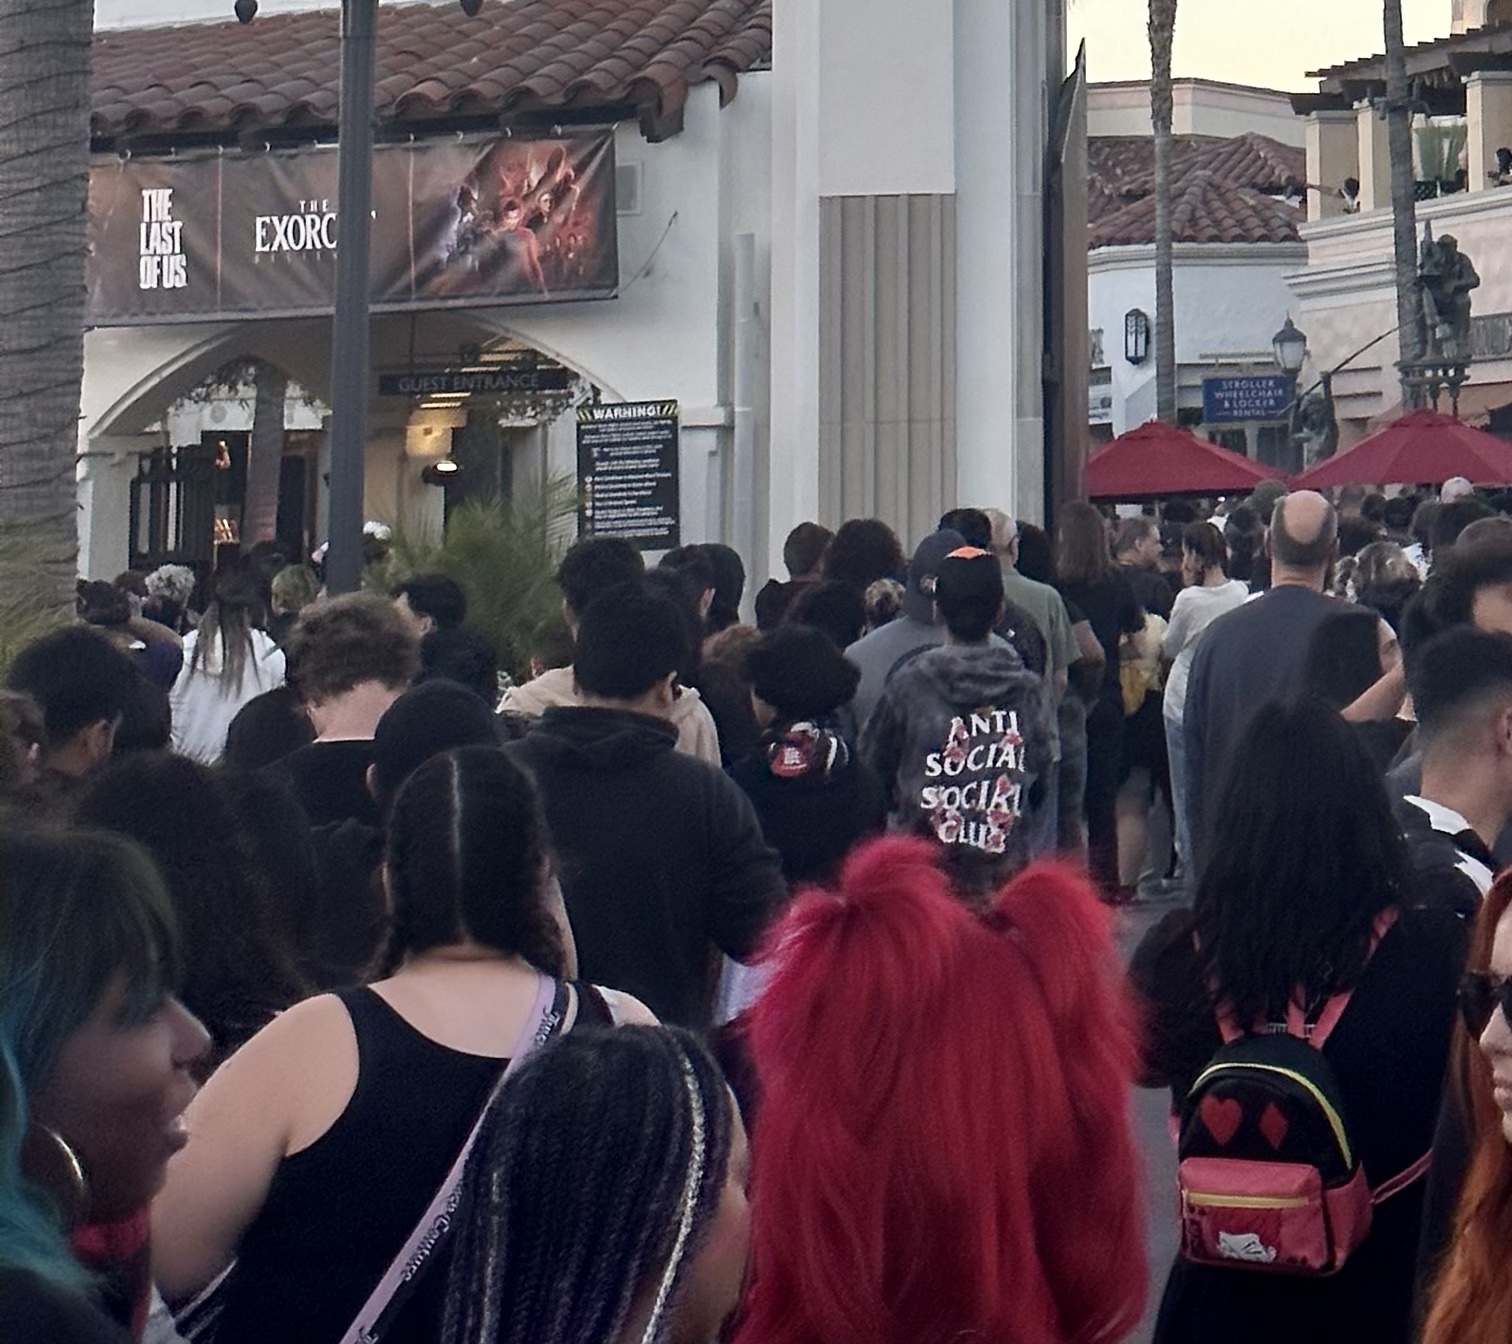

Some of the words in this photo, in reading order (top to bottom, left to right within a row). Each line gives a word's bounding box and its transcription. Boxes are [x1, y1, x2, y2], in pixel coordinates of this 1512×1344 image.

[141, 188, 174, 222] THE
[300, 198, 329, 213] THE
[140, 221, 184, 255] LAST
[255, 212, 338, 252] EXORC
[139, 255, 162, 290] OF
[162, 253, 188, 289] US
[399, 376, 449, 393] GUEST
[453, 373, 539, 390] ENTRANCE
[1214, 388, 1283, 399] WHEELCHAIR
[1222, 379, 1275, 390] STROLLER
[592, 404, 661, 420] WARNING!
[1233, 398, 1276, 409] LOCKER
[948, 711, 1020, 742] ANTI
[925, 742, 1026, 777] SOCIAL
[920, 779, 1022, 818] SOCIAL
[937, 819, 1006, 854] CLUB
[534, 1004, 561, 1046] Juic
[401, 1214, 451, 1282] Couture
